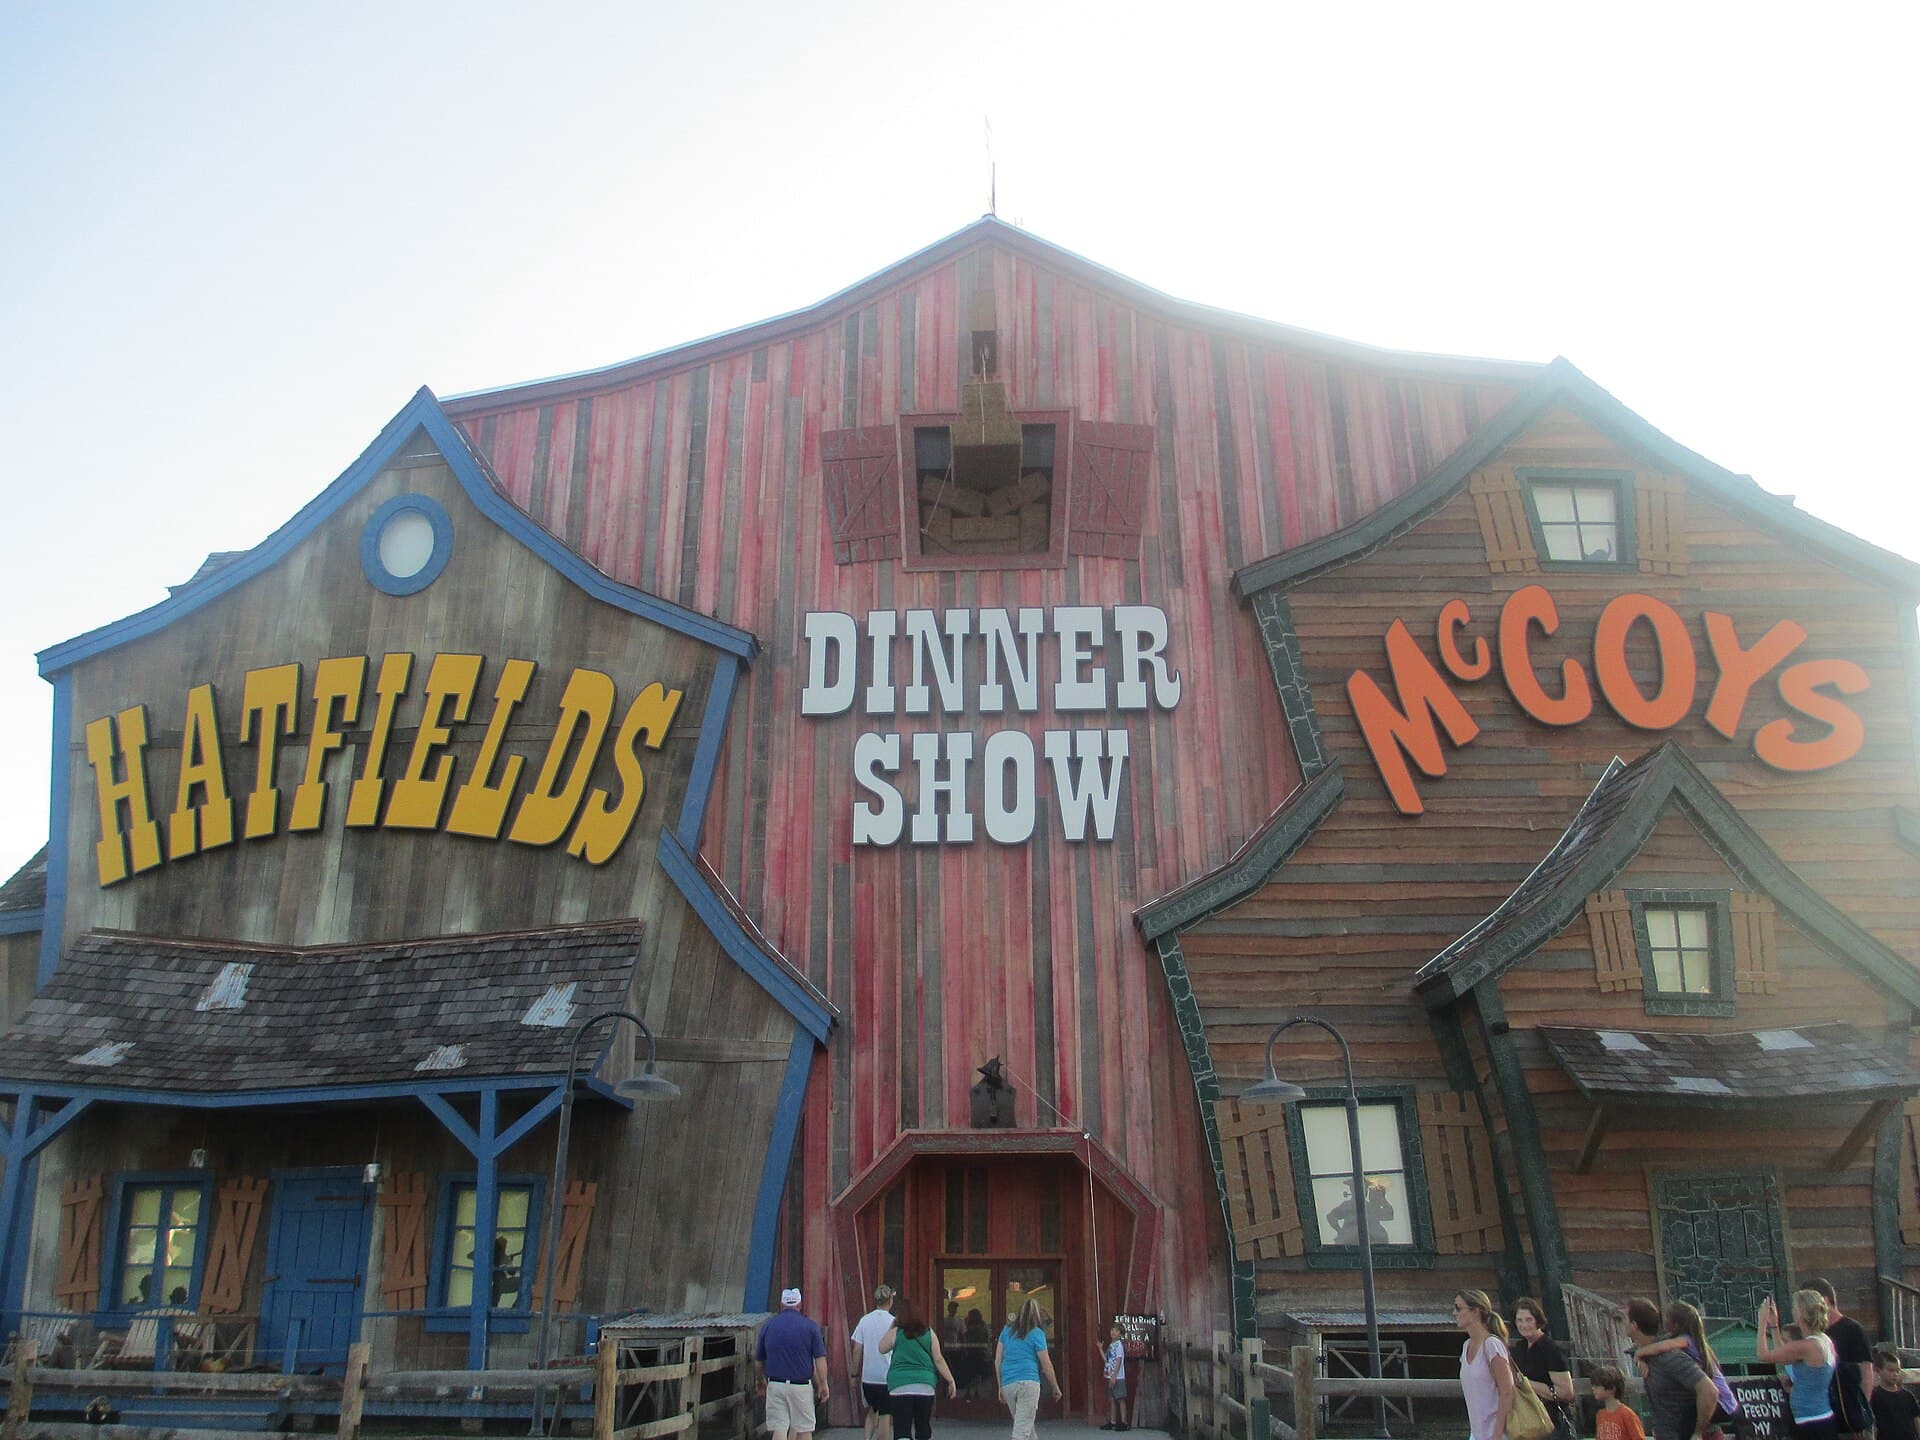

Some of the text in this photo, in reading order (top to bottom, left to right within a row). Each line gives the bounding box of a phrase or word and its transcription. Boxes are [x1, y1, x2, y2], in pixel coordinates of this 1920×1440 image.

[801, 605, 1182, 716] DINNER
[85, 652, 682, 887] HATFIELDS
[851, 729, 1131, 847] SHOW
[1752, 1421, 1770, 1436] MY
[1768, 1388, 1784, 1403] BE
